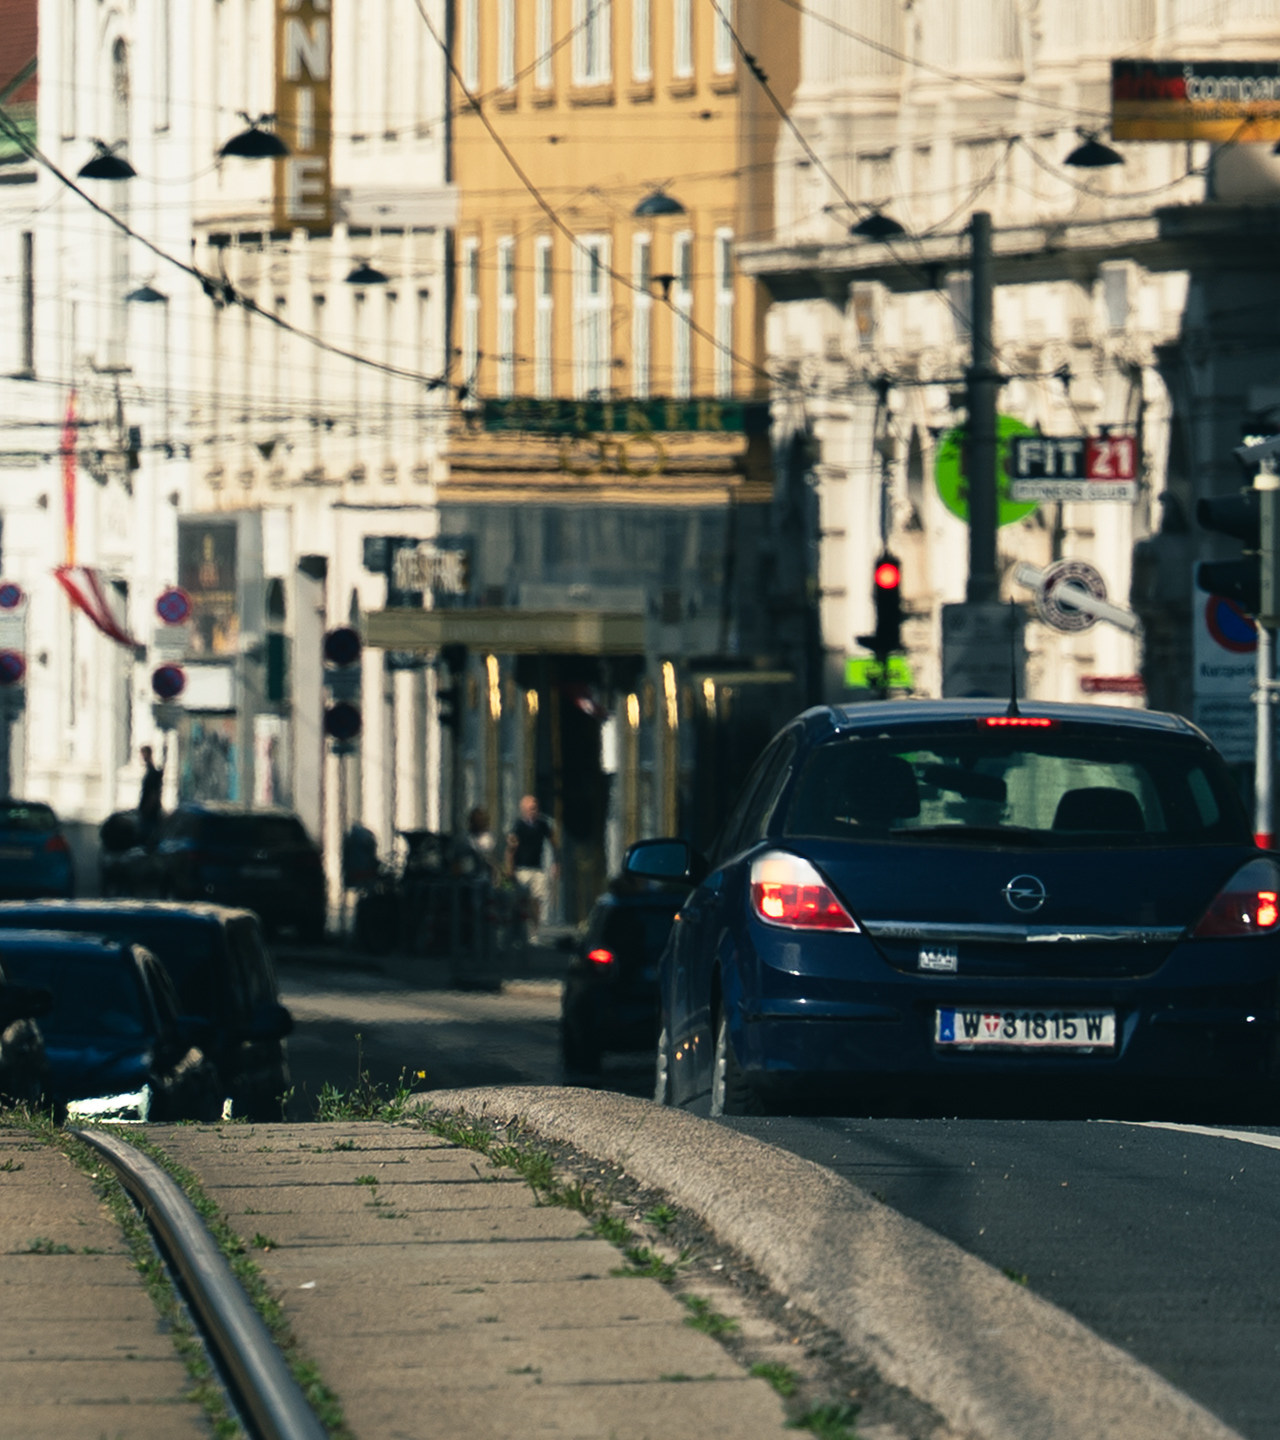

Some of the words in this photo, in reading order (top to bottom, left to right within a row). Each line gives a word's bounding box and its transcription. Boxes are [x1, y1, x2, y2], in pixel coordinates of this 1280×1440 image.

[1017, 440, 1083, 476] FIT
[1091, 440, 1134, 477] 21
[963, 1011, 981, 1038] W
[1003, 1012, 1078, 1040] 31815
[1085, 1013, 1103, 1041] W
